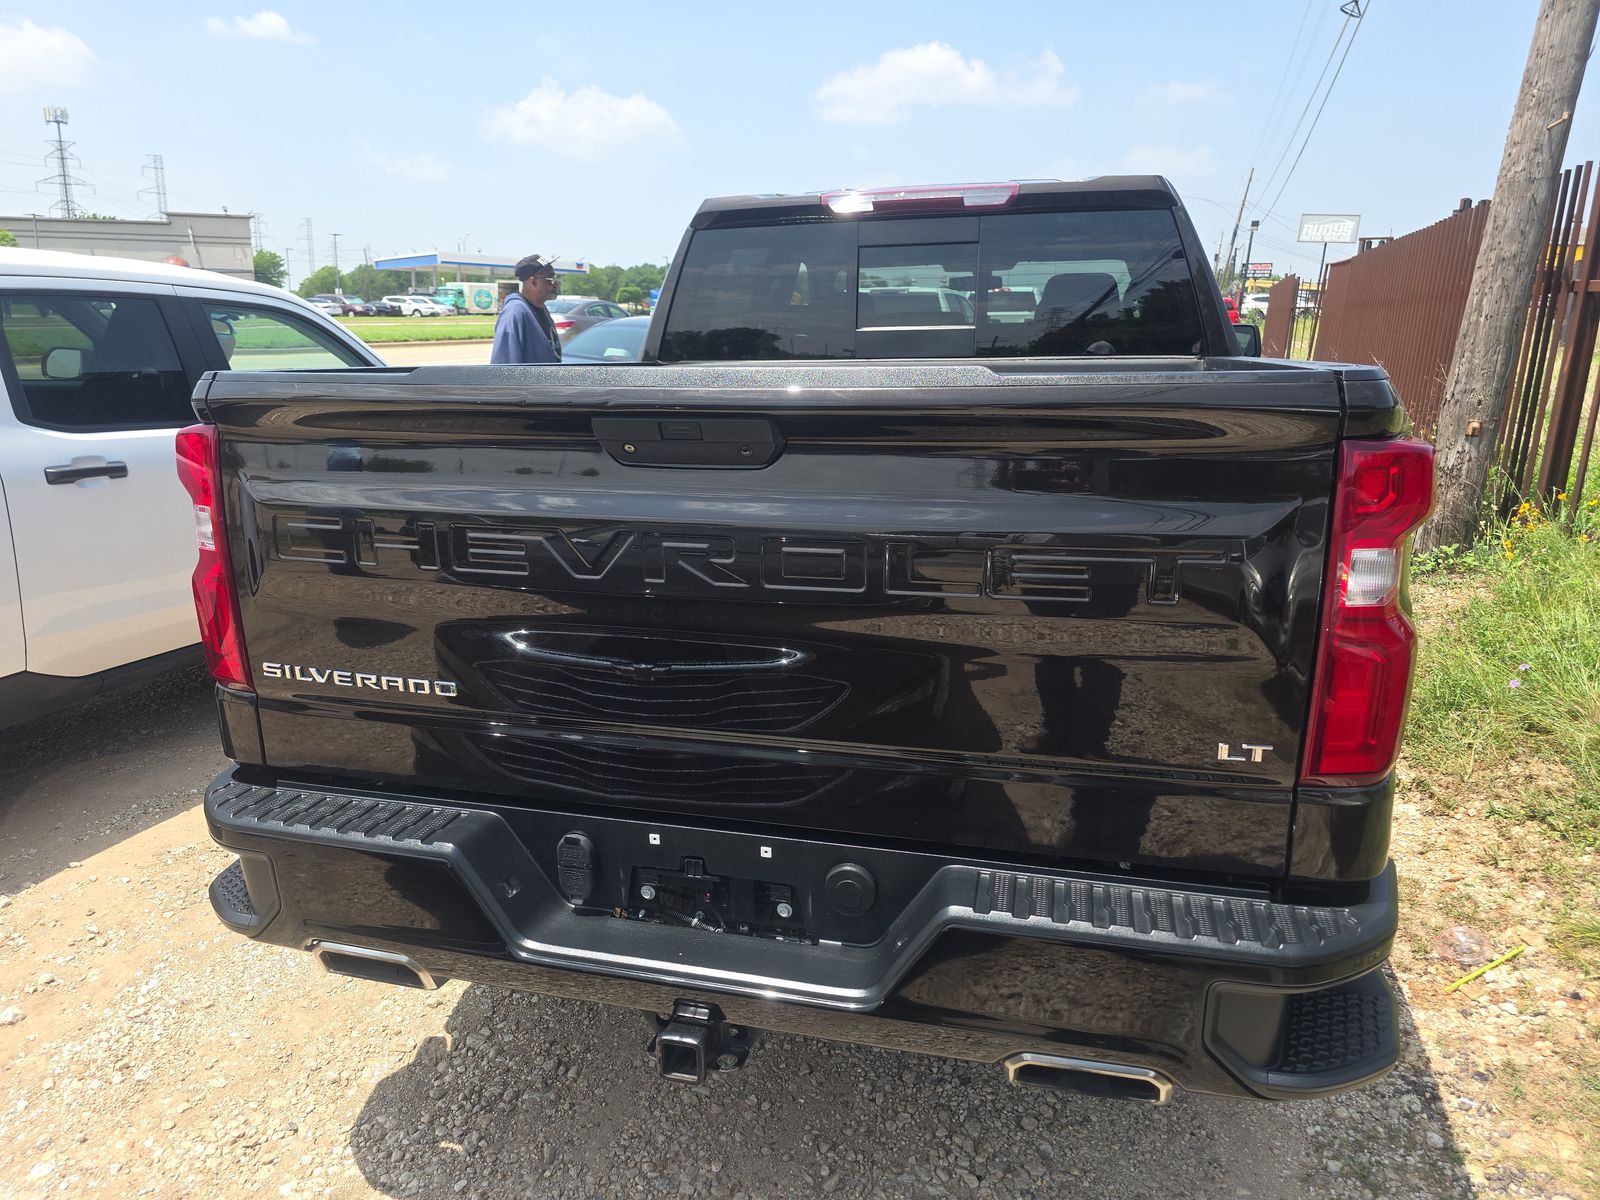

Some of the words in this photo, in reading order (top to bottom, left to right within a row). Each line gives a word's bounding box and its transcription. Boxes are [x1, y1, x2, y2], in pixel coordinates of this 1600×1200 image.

[272, 513, 1228, 605] CHEVROLET
[262, 661, 458, 697] SILVERADO
[1217, 742, 1274, 762] LT
